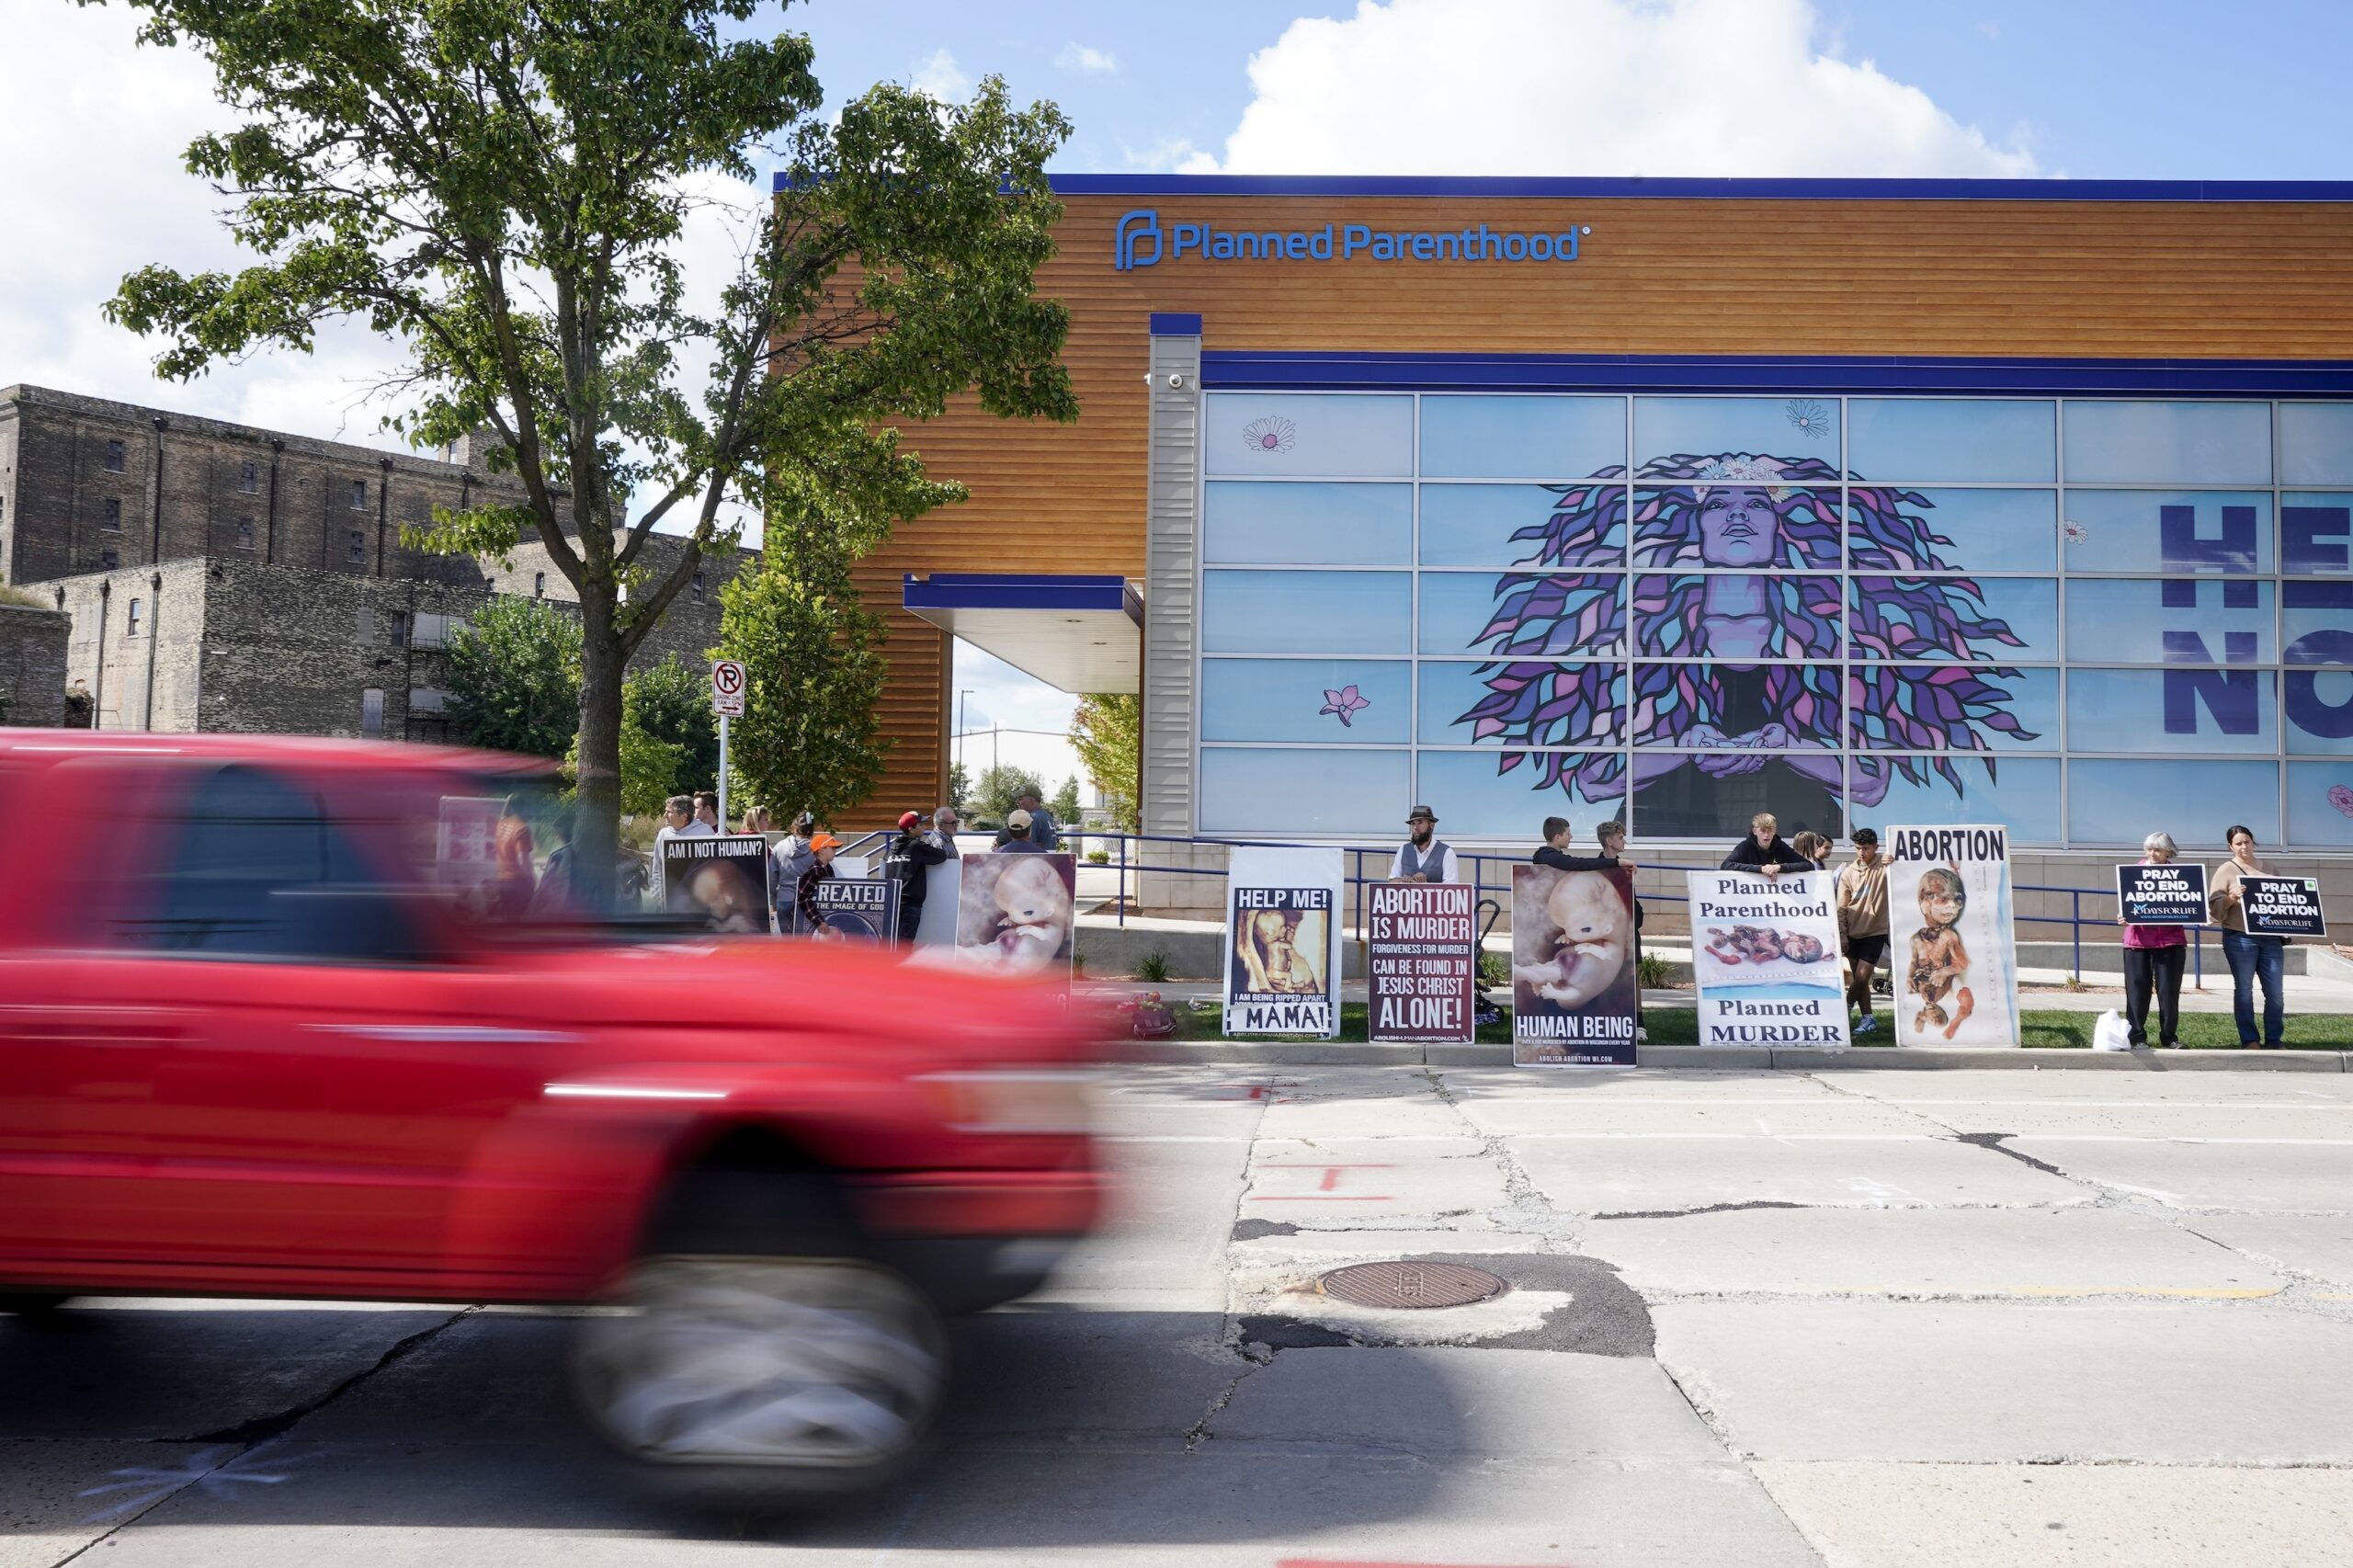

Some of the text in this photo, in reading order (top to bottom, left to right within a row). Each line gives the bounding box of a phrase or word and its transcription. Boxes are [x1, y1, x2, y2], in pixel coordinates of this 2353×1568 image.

[1173, 223, 1579, 262] Planned Parenthood
[2161, 505, 2353, 608] HE
[667, 840, 763, 859] AM I NOT HUMAN?
[1894, 830, 2005, 861] ABORTION
[2142, 869, 2180, 880] PRAY
[1717, 879, 1808, 894] Planned
[2134, 881, 2189, 892] TO END
[2260, 881, 2298, 893] PRAY
[1238, 889, 1327, 908] HELP ME!
[1372, 888, 1469, 915] ABORTION
[2125, 891, 2202, 903] ABORTION
[2254, 892, 2308, 905] TO END
[1699, 901, 1829, 917] Parenthood
[2248, 903, 2319, 916] ABORTION
[1371, 916, 1470, 940] IS MURDER
[1372, 943, 1469, 955] FORGIVENESS FOR MURDER
[1372, 959, 1468, 975] CAN BE FOUND IN
[1377, 976, 1464, 995] JESUS CHRIST
[1234, 993, 1238, 1001] I
[1252, 994, 1274, 1002] BEING
[1275, 994, 1301, 1003] RIPPED
[1302, 994, 1325, 1003] APART
[1379, 996, 1462, 1029] ALONE!
[1717, 999, 1822, 1016] Planned
[1245, 1005, 1324, 1030] MAMA!
[1517, 1015, 1633, 1038] HUMAN BEING
[1710, 1025, 1843, 1042] MURDER
